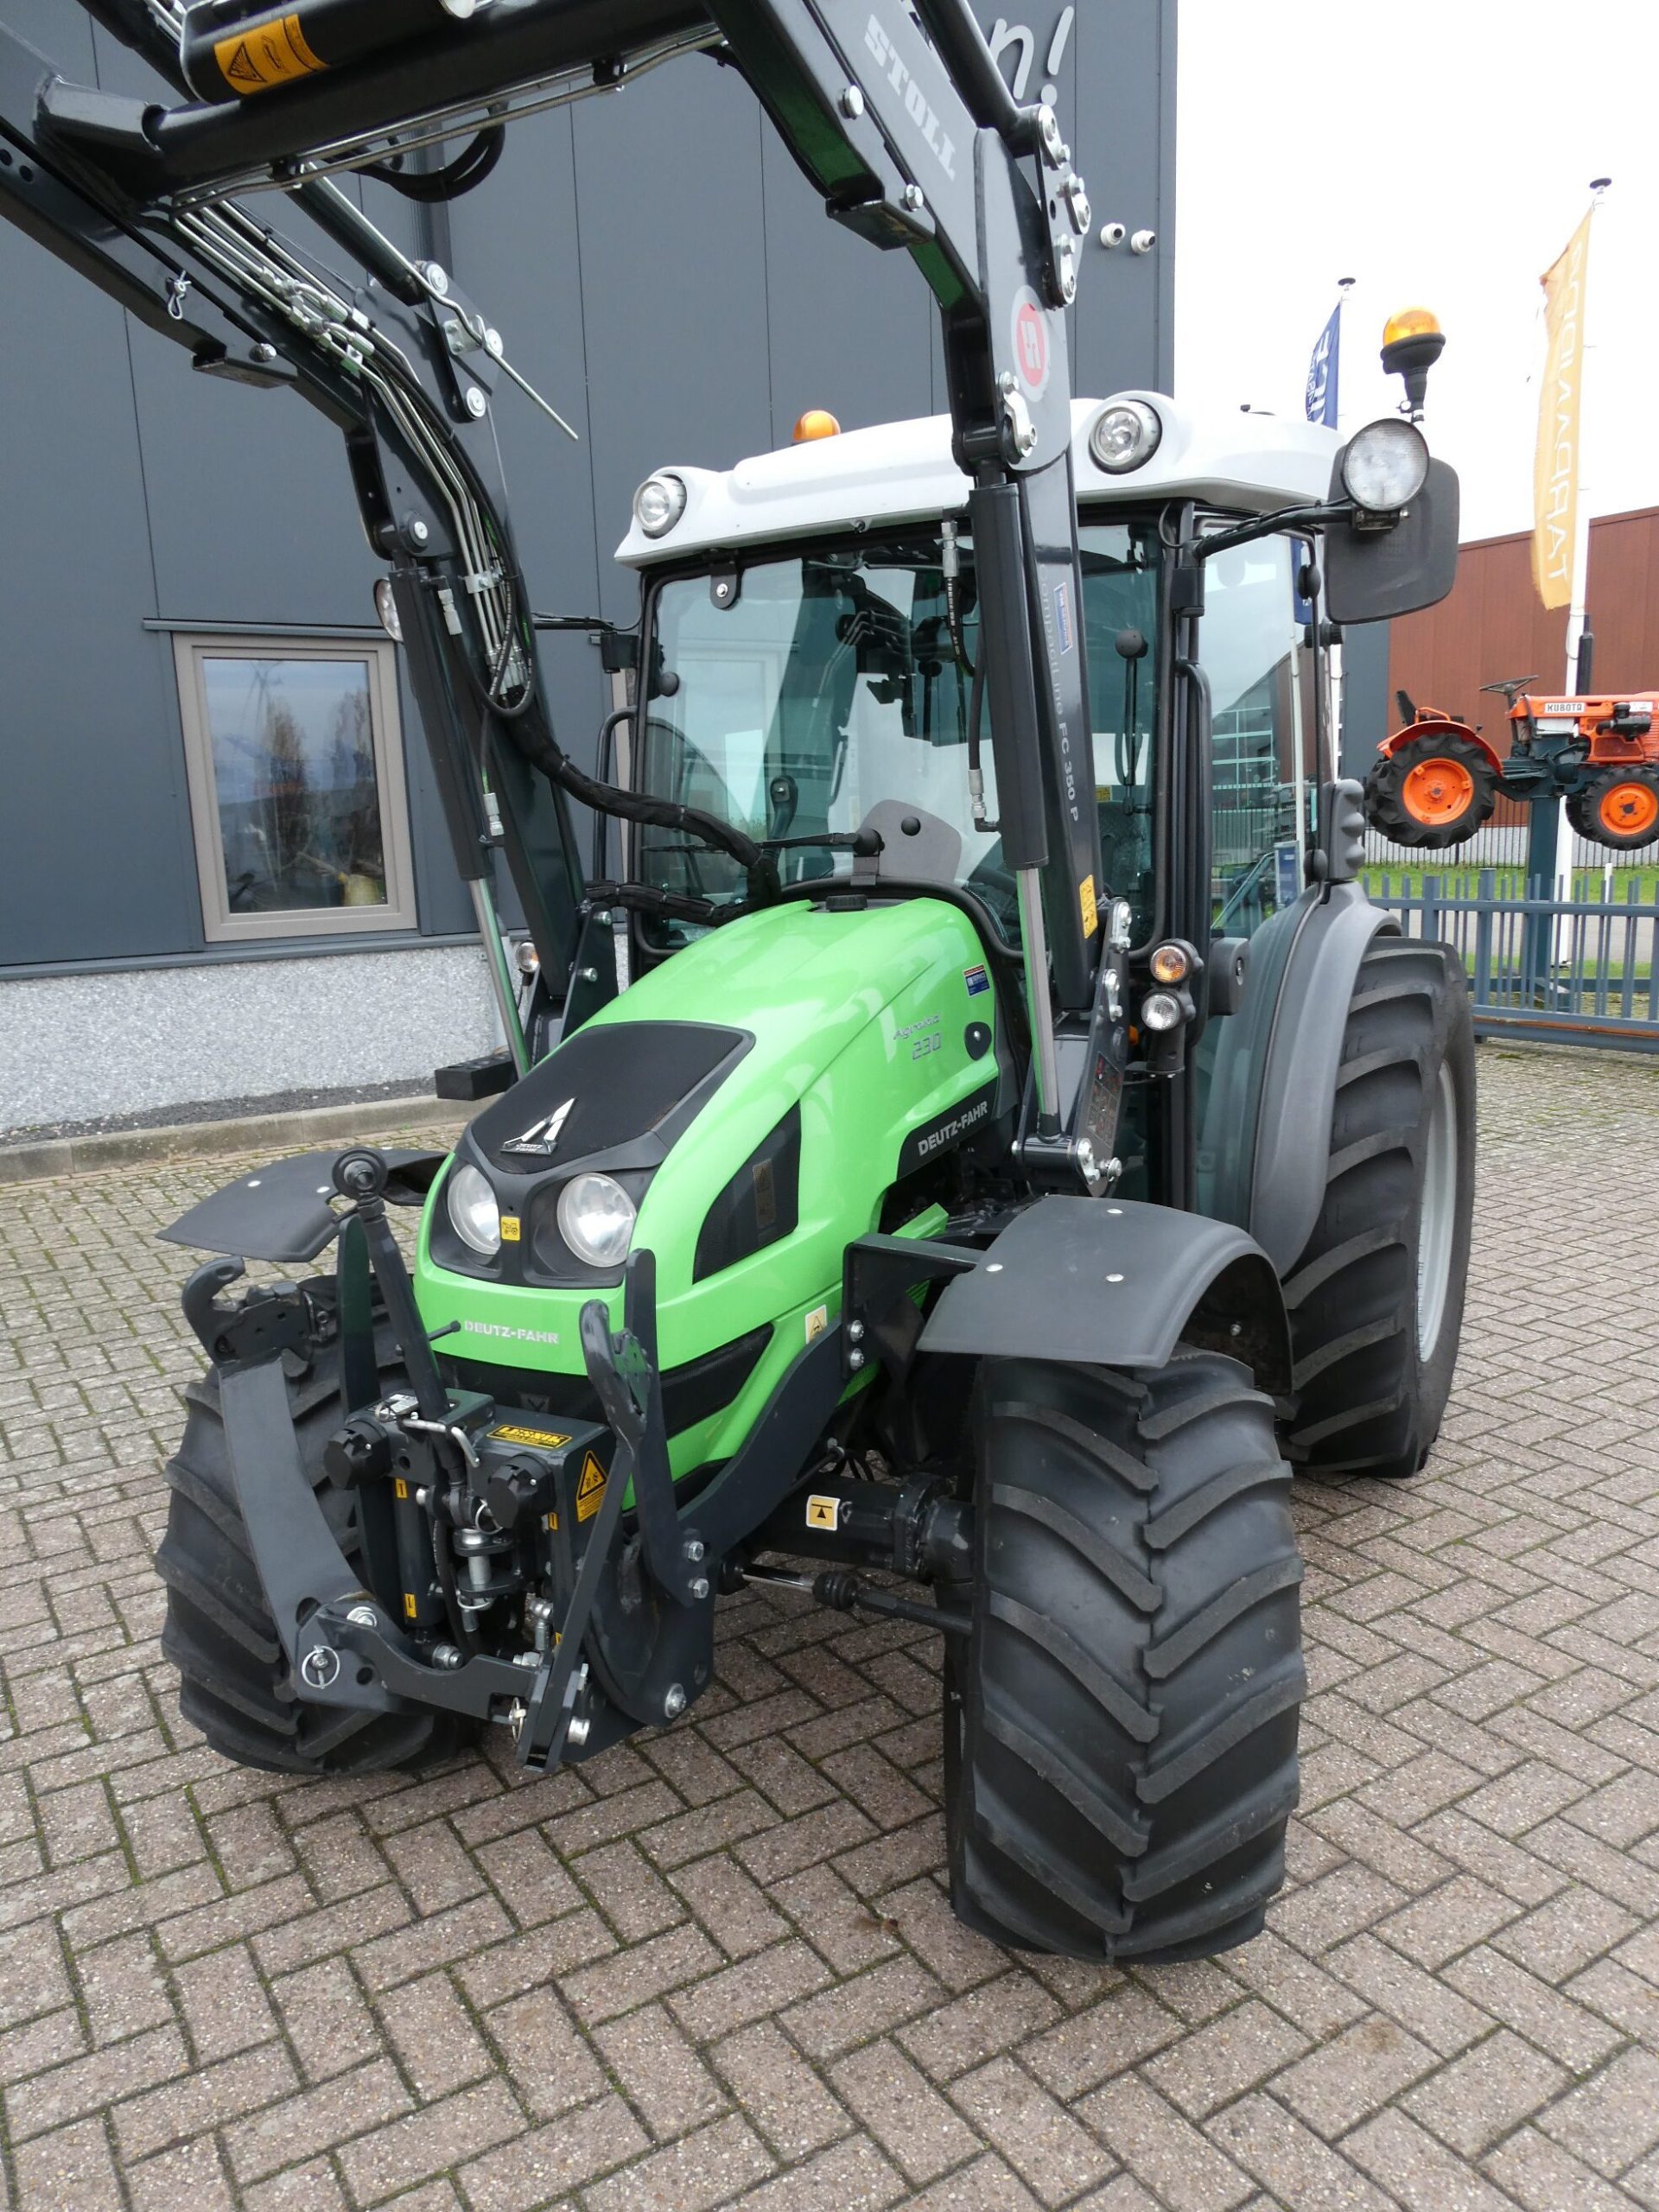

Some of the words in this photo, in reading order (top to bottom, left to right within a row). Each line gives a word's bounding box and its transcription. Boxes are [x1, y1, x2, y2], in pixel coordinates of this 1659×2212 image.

[865, 14, 955, 181] STOLL
[1547, 703, 1582, 712] KUBOTA
[1058, 722, 1070, 754] FC
[1065, 760, 1076, 801] 350
[1071, 806, 1079, 822] P
[912, 1033, 941, 1060] 230
[918, 1101, 988, 1156] DEUTZ-FAHR
[464, 1320, 560, 1344] DEUTZ-FAHR
